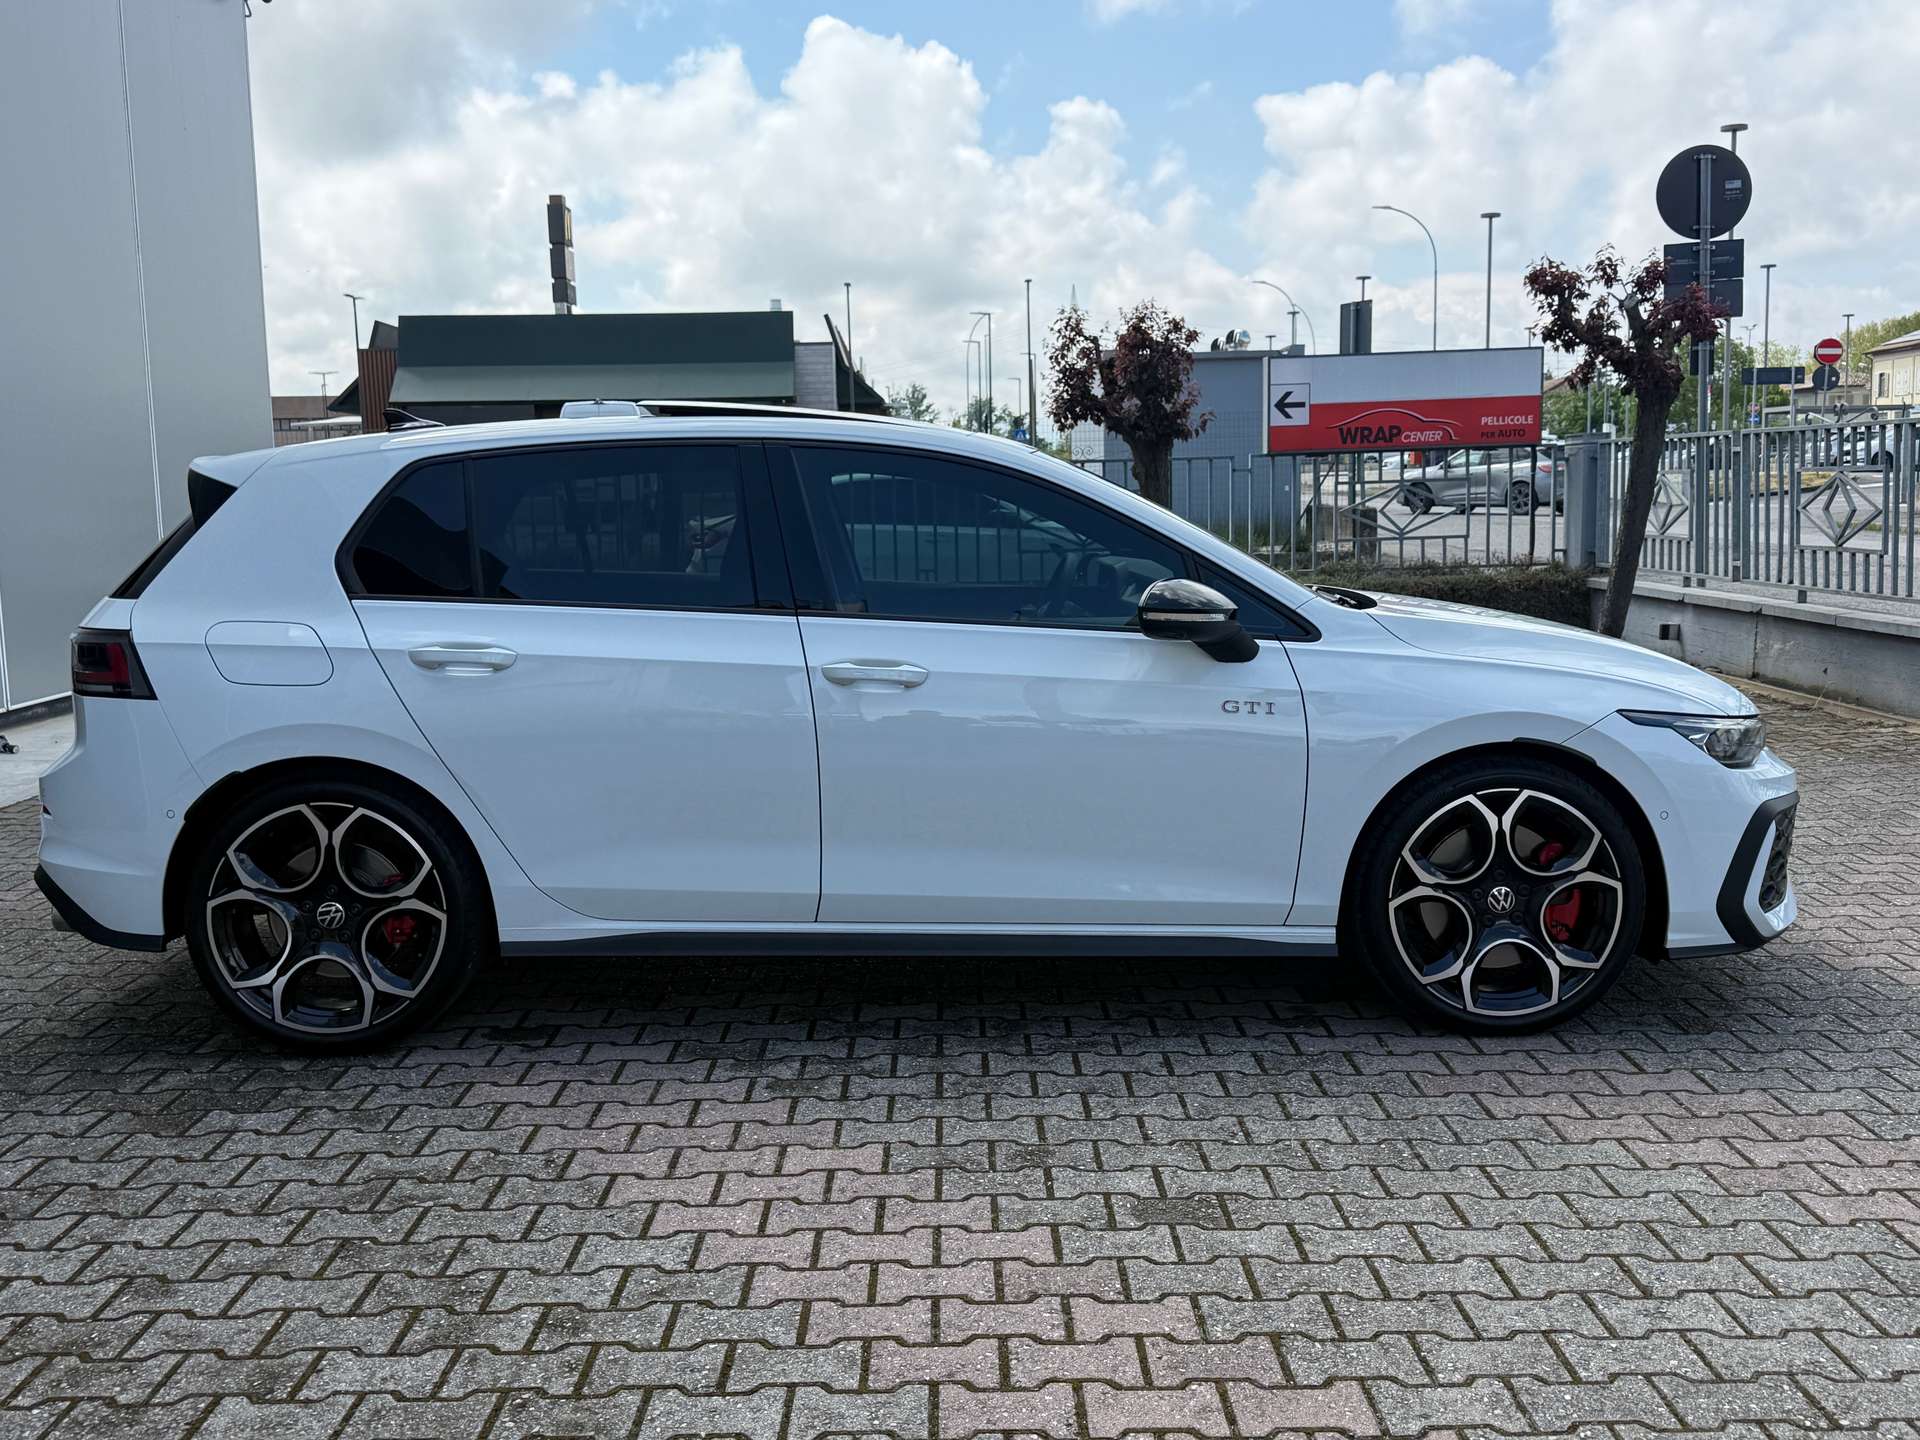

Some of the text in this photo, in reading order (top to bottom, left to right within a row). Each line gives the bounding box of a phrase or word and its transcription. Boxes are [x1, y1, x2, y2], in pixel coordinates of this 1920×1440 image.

[1481, 415, 1534, 425] PELLICOLE
[1339, 425, 1443, 445] WRAP CENTER
[1481, 429, 1526, 439] PER AUTO
[1222, 700, 1276, 715] GTI
